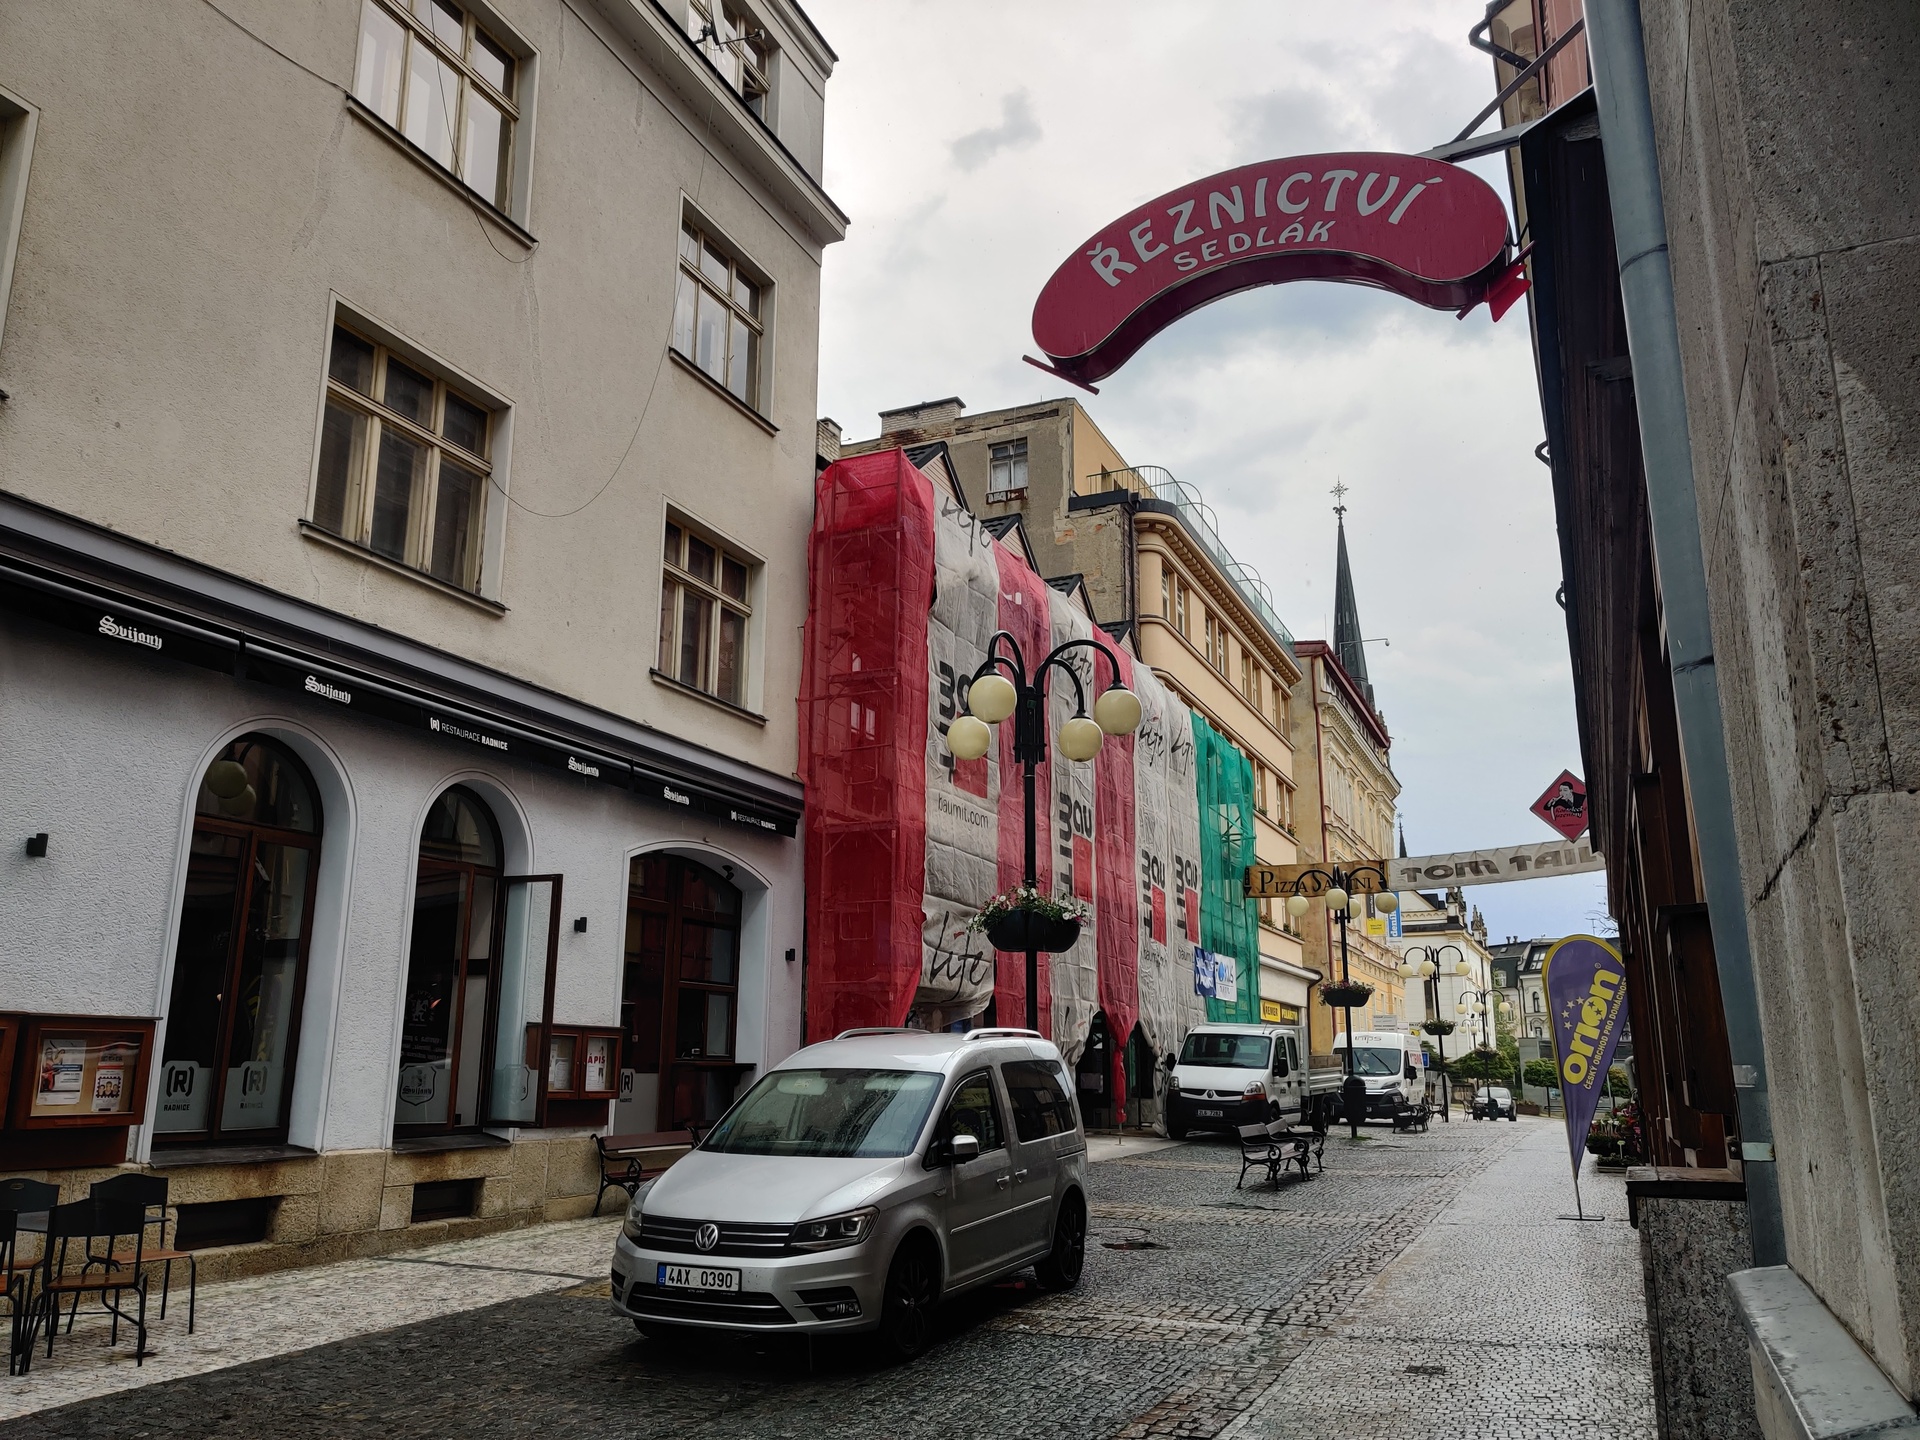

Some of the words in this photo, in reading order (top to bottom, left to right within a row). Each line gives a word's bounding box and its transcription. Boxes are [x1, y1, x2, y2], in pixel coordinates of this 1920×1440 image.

[1086, 169, 1443, 287] ŘEZNICTVÍ
[1173, 216, 1336, 271] SEDLÁK
[99, 615, 163, 650] Svijany
[305, 675, 351, 704] Svijany
[441, 723, 480, 742] RESTAURACE
[481, 736, 508, 751] RADNICE
[568, 757, 599, 778] Svijany
[938, 793, 989, 828] baumit.com
[1401, 859, 1500, 883] TOM
[1563, 969, 1621, 1085] orion
[1583, 1065, 1598, 1090] ČESKÝ
[1592, 1035, 1608, 1065] OBCHOD
[1604, 1019, 1614, 1036] PRO
[163, 1103, 190, 1112] RADNICE
[668, 1267, 691, 1286] 4AX
[700, 1270, 733, 1289] 0390
